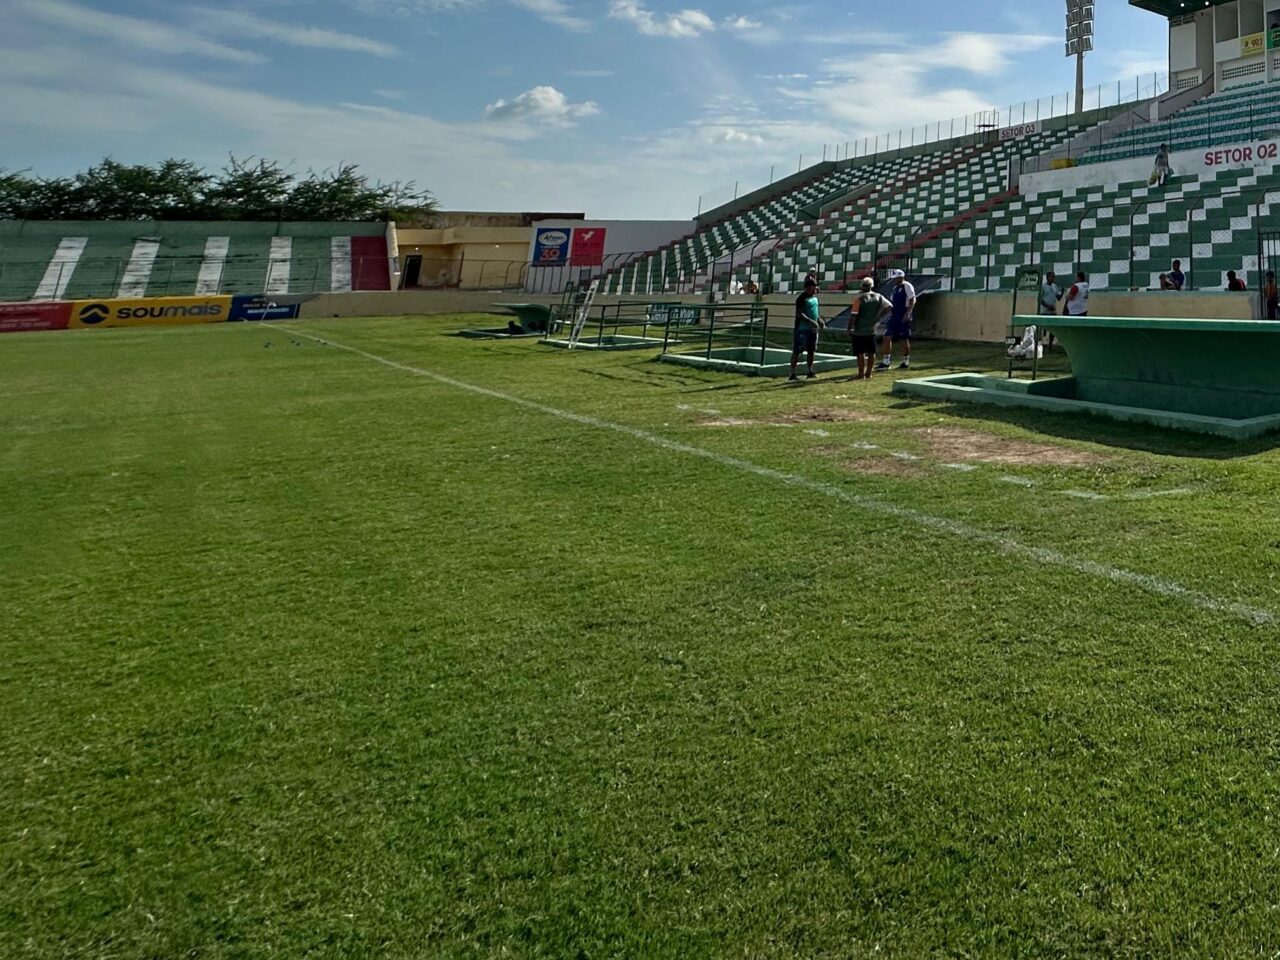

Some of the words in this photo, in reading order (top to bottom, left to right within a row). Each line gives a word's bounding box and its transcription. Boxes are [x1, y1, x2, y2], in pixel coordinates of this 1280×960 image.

[1001, 126, 1024, 138] SETOR
[1204, 147, 1252, 166] SETOR
[1257, 143, 1277, 159] 02
[116, 302, 222, 319] soumais
